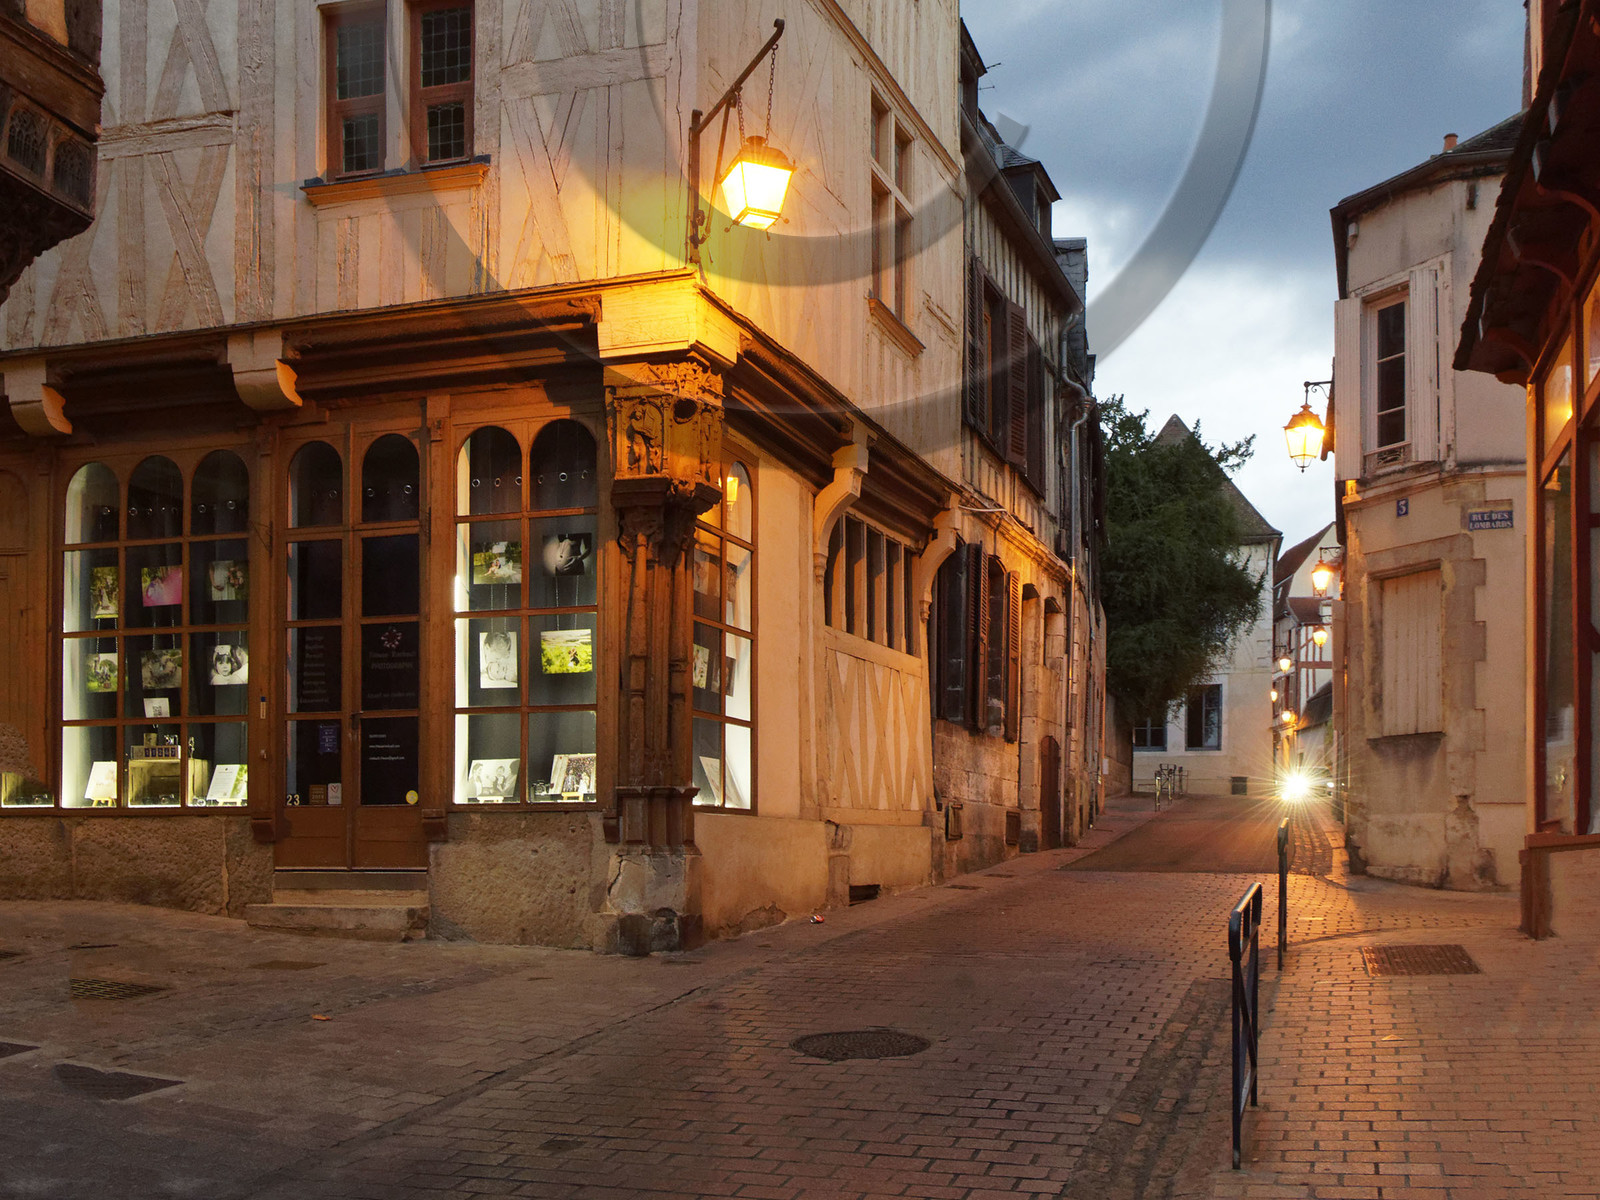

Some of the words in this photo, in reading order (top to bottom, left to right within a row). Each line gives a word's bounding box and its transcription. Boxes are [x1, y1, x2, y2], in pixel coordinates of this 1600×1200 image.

[1472, 513, 1490, 521] RUE
[1491, 511, 1509, 520] DES
[1469, 520, 1512, 529] LOMBARDS
[286, 794, 300, 805] 23
